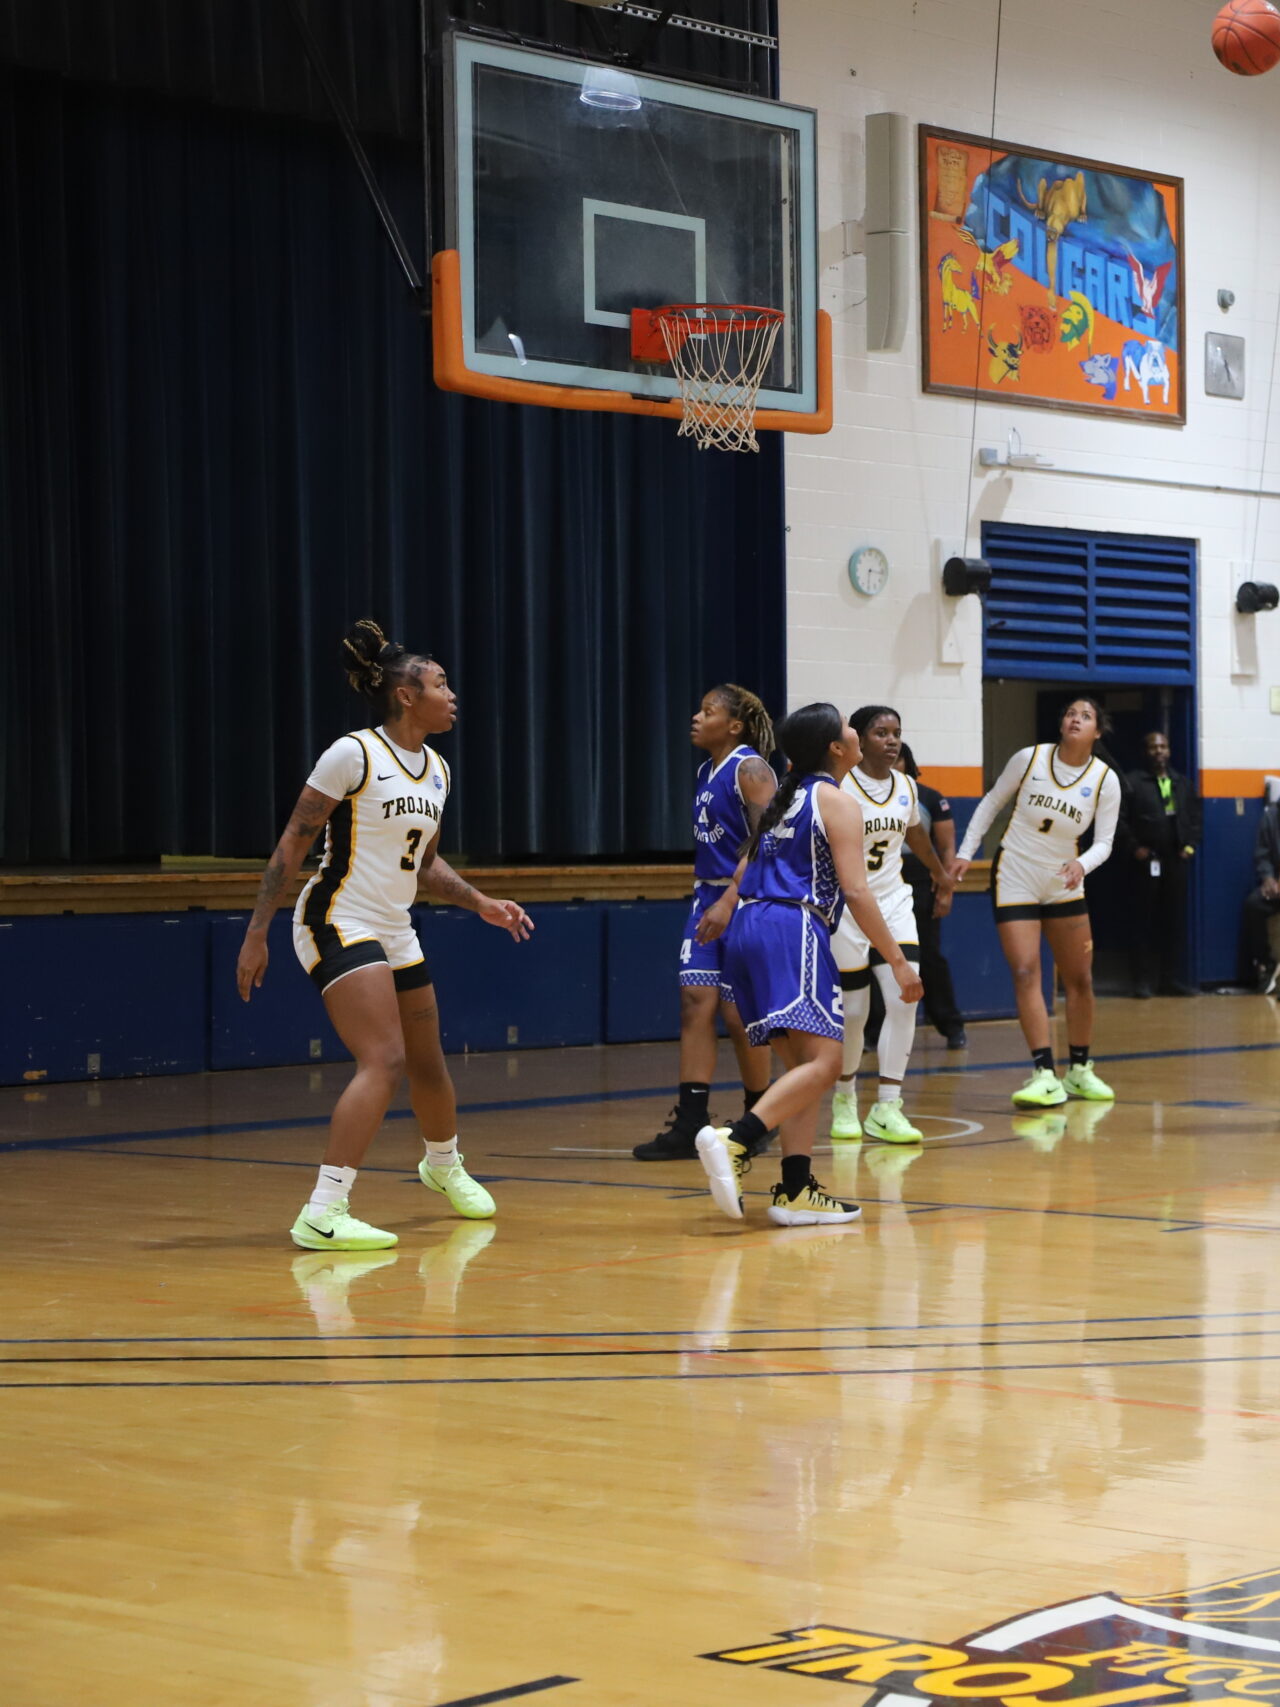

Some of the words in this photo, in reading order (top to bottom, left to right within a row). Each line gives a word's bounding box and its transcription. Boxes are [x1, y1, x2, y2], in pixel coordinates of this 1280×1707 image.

[698, 806, 710, 828] 4
[1027, 793, 1084, 824] TROJANS
[864, 816, 907, 837] ROJAN
[1038, 817, 1054, 834] 1
[400, 828, 423, 871] 3
[867, 840, 889, 871] 5
[680, 938, 693, 965] 4
[713, 1625, 1274, 1707] TROJ
